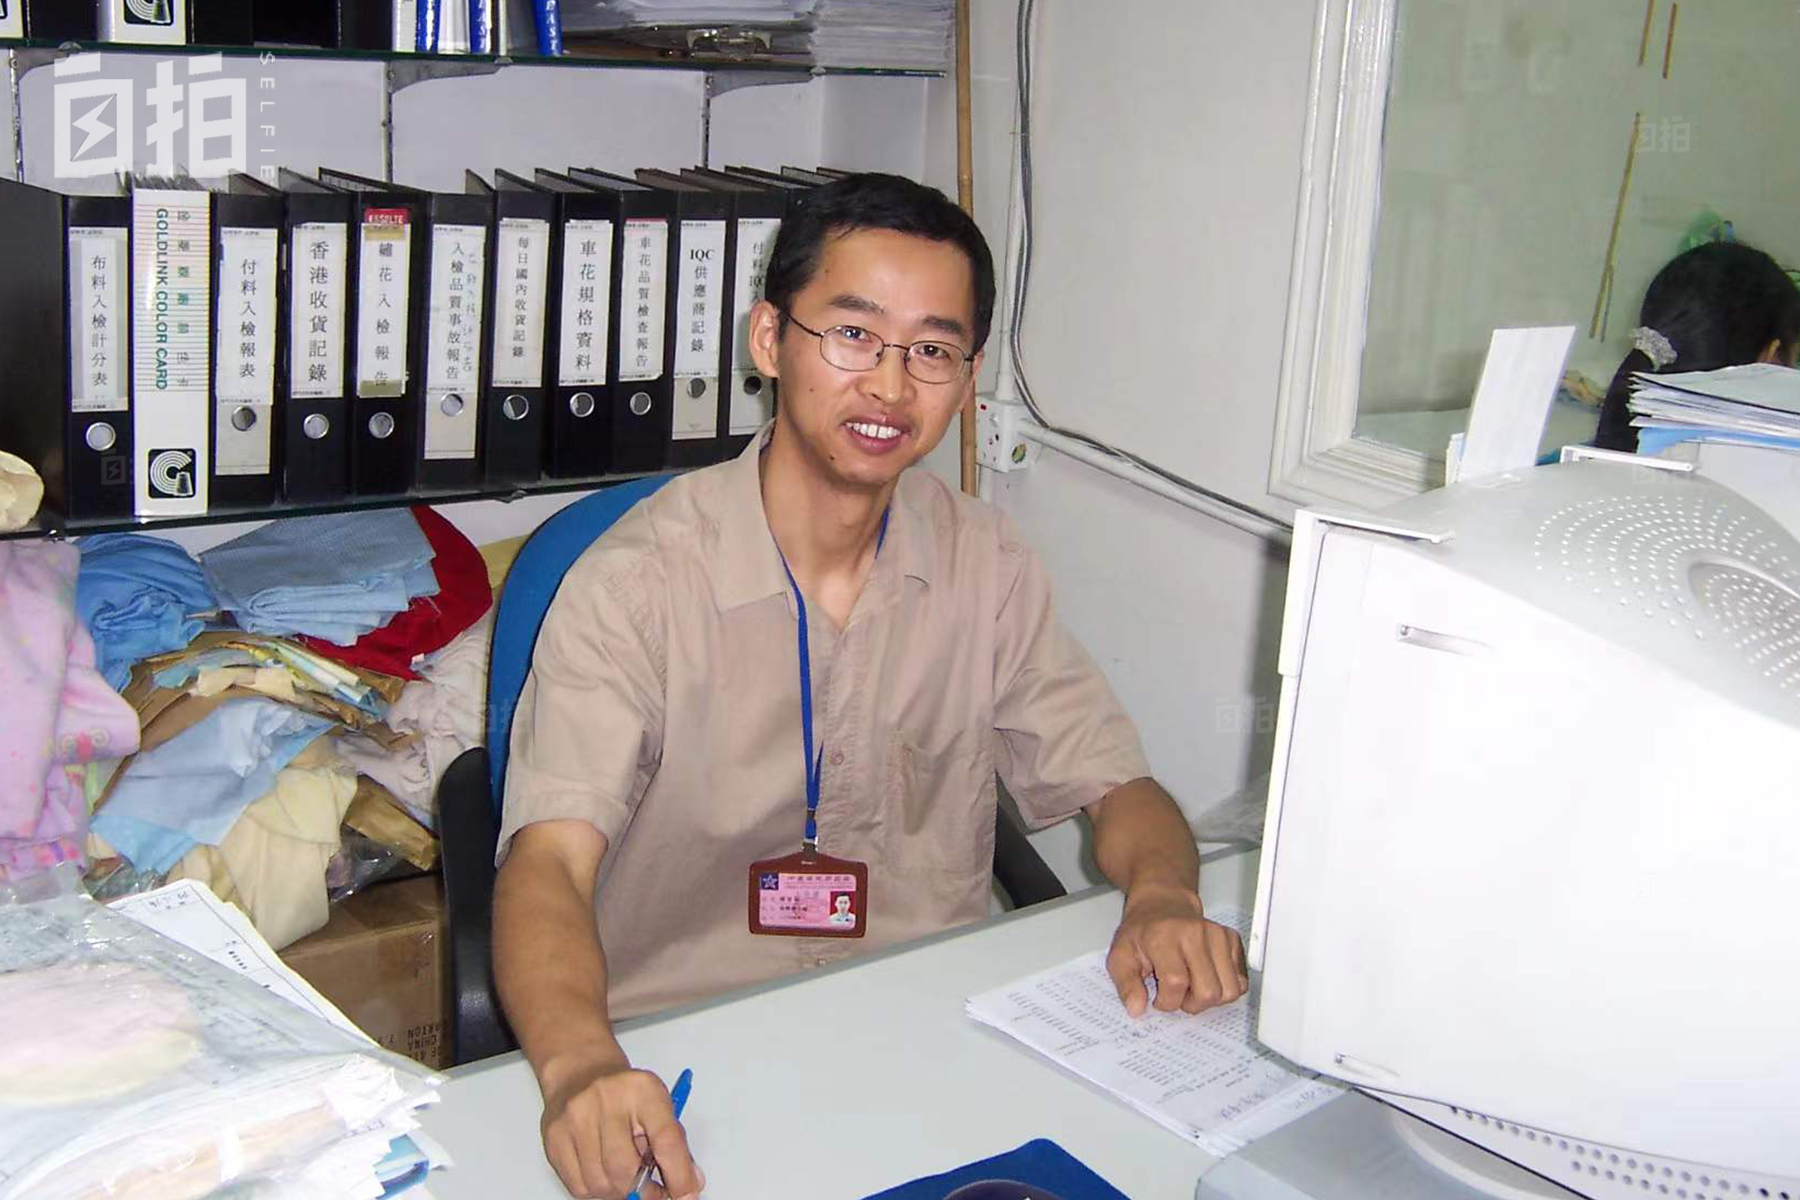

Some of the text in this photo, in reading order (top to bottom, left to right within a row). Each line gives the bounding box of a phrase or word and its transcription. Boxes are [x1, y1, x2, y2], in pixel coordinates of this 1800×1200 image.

[90, 254, 108, 387] 布料入檢計分表
[155, 207, 169, 390] GOLDLINK COLOR CARD
[238, 258, 257, 378] 付料入檢報表
[308, 241, 329, 382] 香港收貨記錄
[511, 236, 530, 358] 每日國內收貨記錄
[575, 240, 597, 371] 車花規格資料
[635, 236, 652, 368] 車花品質檢查報告
